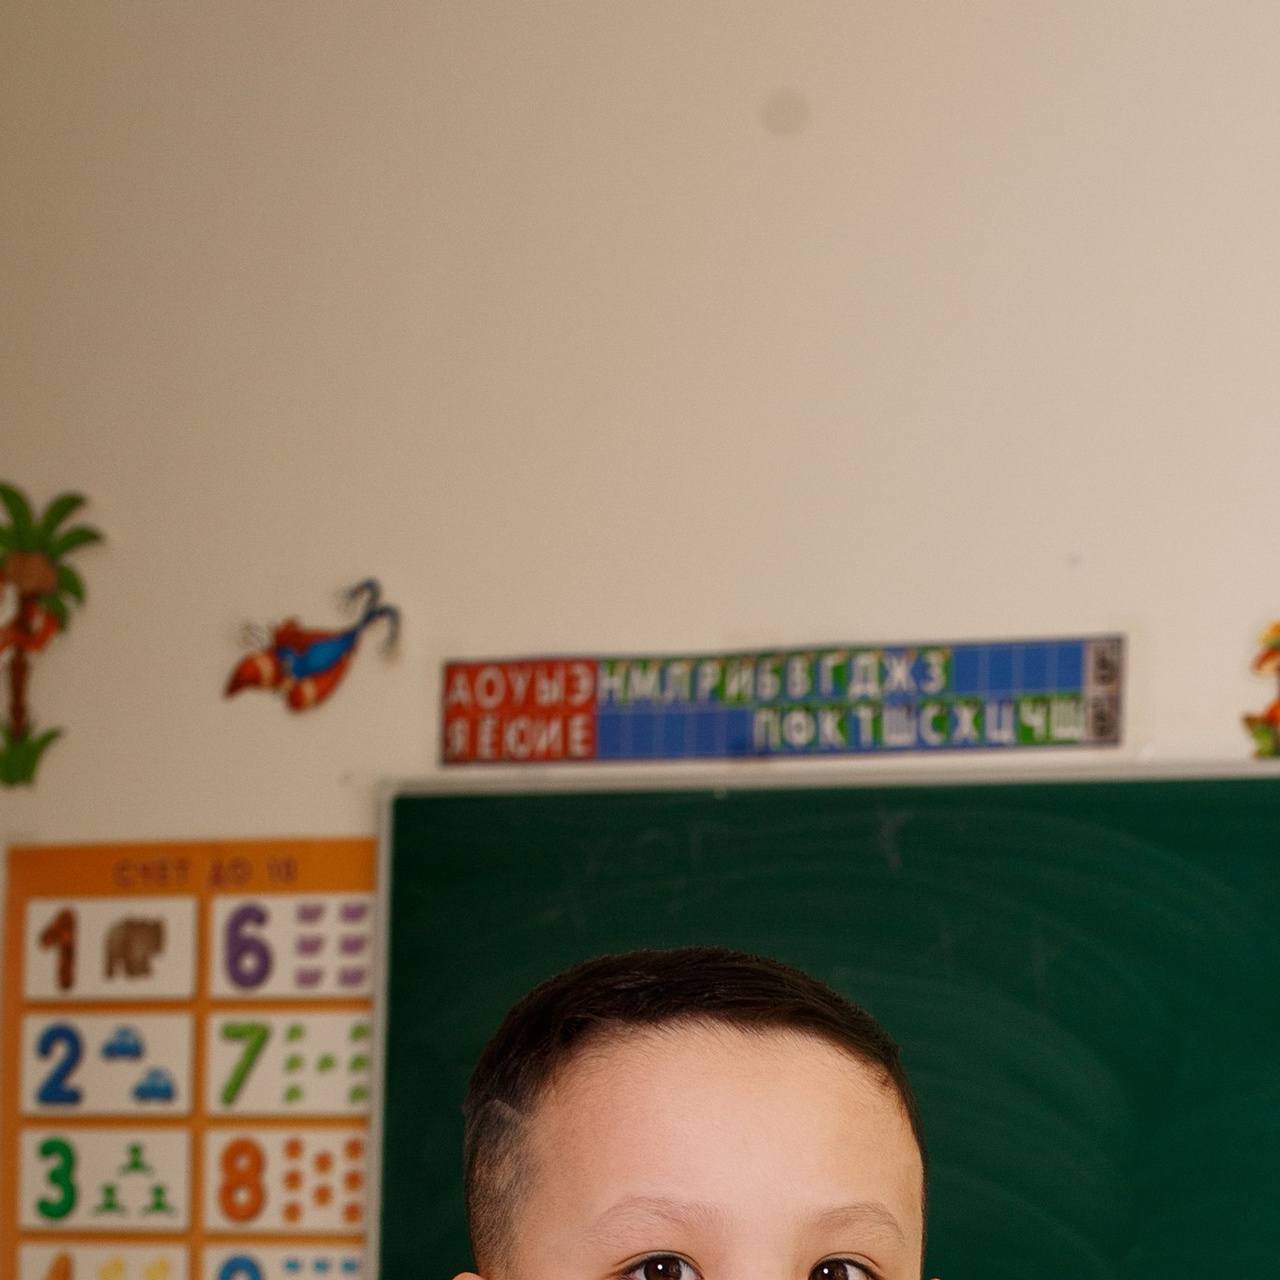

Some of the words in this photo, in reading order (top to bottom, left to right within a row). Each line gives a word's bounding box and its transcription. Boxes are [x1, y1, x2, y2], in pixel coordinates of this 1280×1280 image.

[38, 908, 78, 991] 1
[224, 904, 272, 991] 6
[35, 1023, 83, 1106] 2
[220, 1022, 271, 1106] 7
[36, 1138, 77, 1221] 3
[218, 1136, 266, 1223] 8
